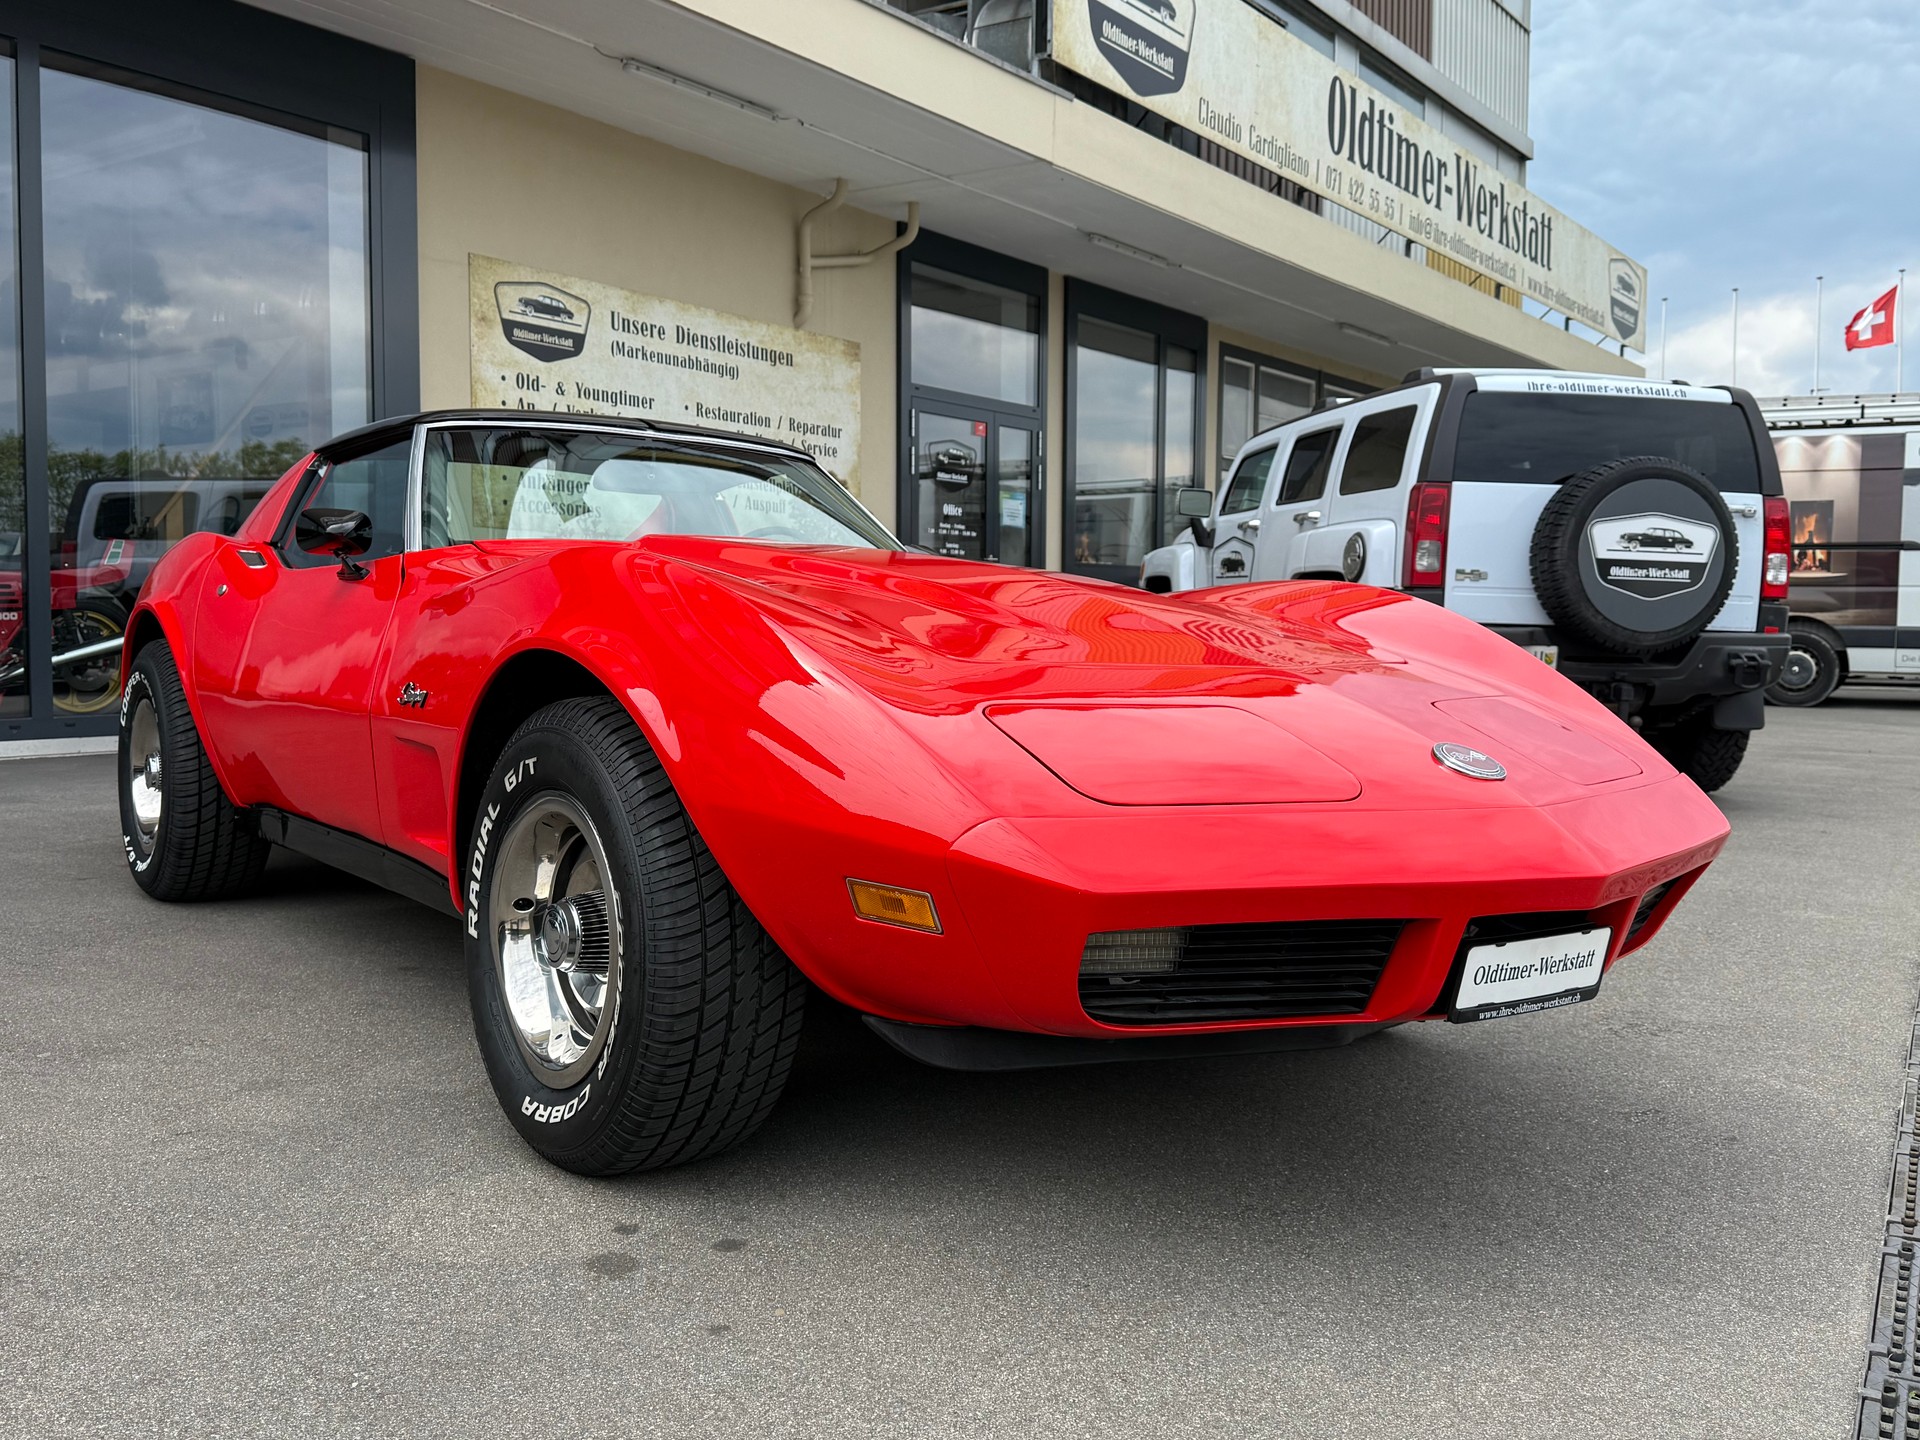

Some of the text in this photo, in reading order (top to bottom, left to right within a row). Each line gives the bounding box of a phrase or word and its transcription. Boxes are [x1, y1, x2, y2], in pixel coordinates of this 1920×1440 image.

[1102, 20, 1174, 73] Oldtimer-Werkstatt
[1198, 97, 1242, 144] Claudio
[1249, 124, 1309, 178] Cardigliano
[1325, 165, 1342, 195] 071
[1348, 177, 1365, 206] 422
[1368, 188, 1380, 214] 55
[1384, 196, 1396, 221] 55
[1408, 209, 1517, 282] info@ihre-oldtimer-werkstatt.ch
[1328, 76, 1553, 272] Oldtimer-Werkstatt
[513, 327, 574, 348] Oldtimer-Werkstatt
[610, 310, 794, 367] Unsere Dienstleistungen
[610, 340, 740, 381] (Markenunabhängig)
[516, 372, 546, 393] Old-
[555, 381, 566, 396] &
[575, 382, 655, 410] Youngtimer
[1527, 381, 1687, 398] ihre-oldtimer-werkstatt.ch
[695, 401, 771, 429] Restauration
[776, 415, 783, 430] /
[788, 416, 843, 439] Reparatur
[801, 439, 838, 458] Service
[517, 495, 603, 519] Accessories
[1609, 565, 1690, 579] Oldtimer-Werkstatt
[120, 671, 141, 727] COOPER
[467, 756, 538, 940] RADIAL G/T
[1473, 948, 1596, 986] Oldtimer-Werkstatt
[1478, 992, 1581, 1020] www.ihre-oldtimer-werkstatt.ch
[521, 1083, 591, 1124] COBRA
